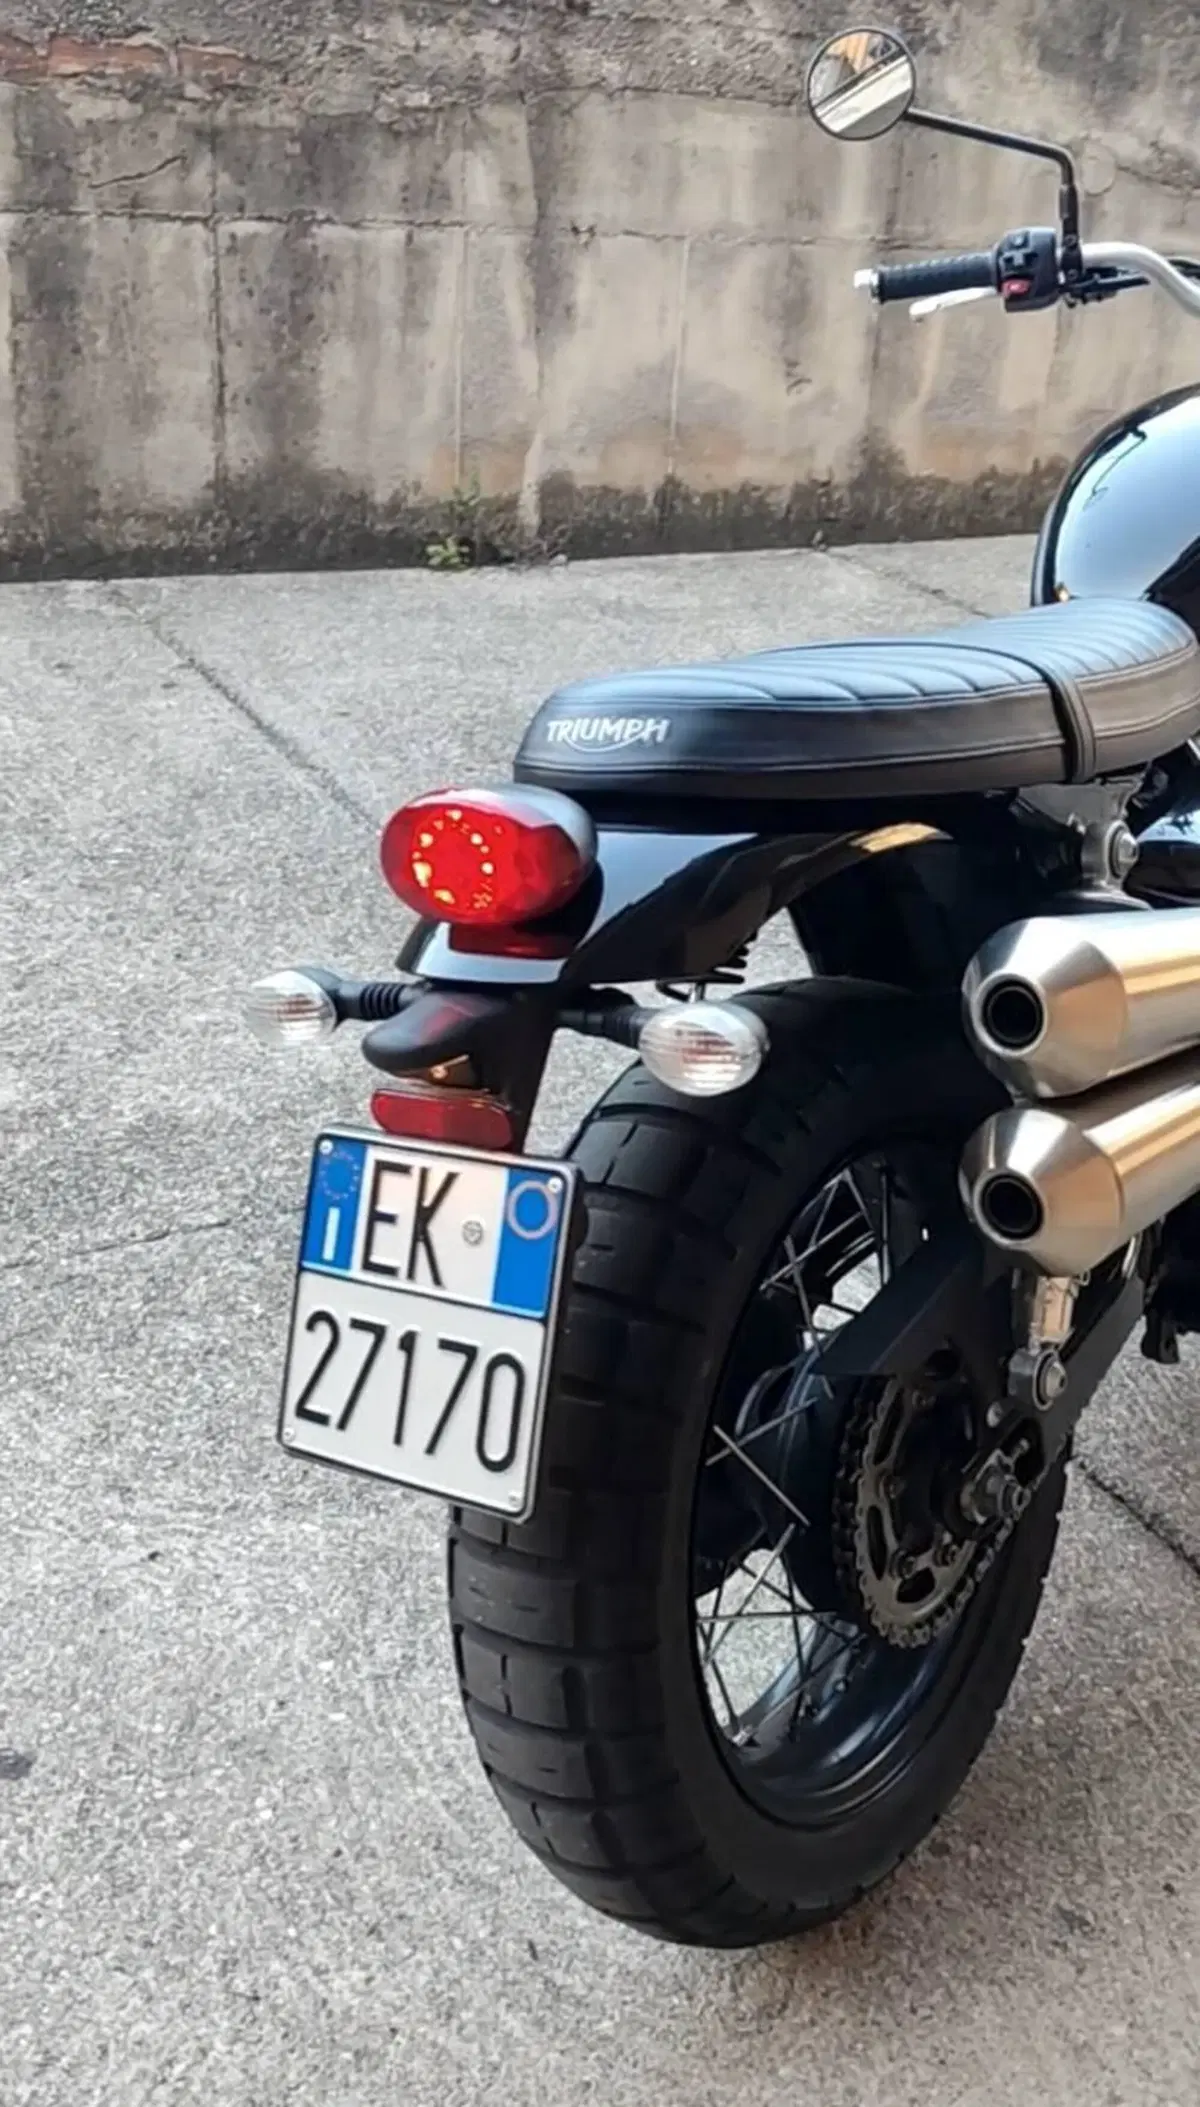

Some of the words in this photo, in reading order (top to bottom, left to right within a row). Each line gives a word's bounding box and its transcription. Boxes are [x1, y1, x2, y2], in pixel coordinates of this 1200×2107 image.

[547, 717, 671, 750] TRIUMPH
[322, 1207, 341, 1261] I
[361, 1159, 460, 1288] EK
[295, 1309, 526, 1473] 27170
